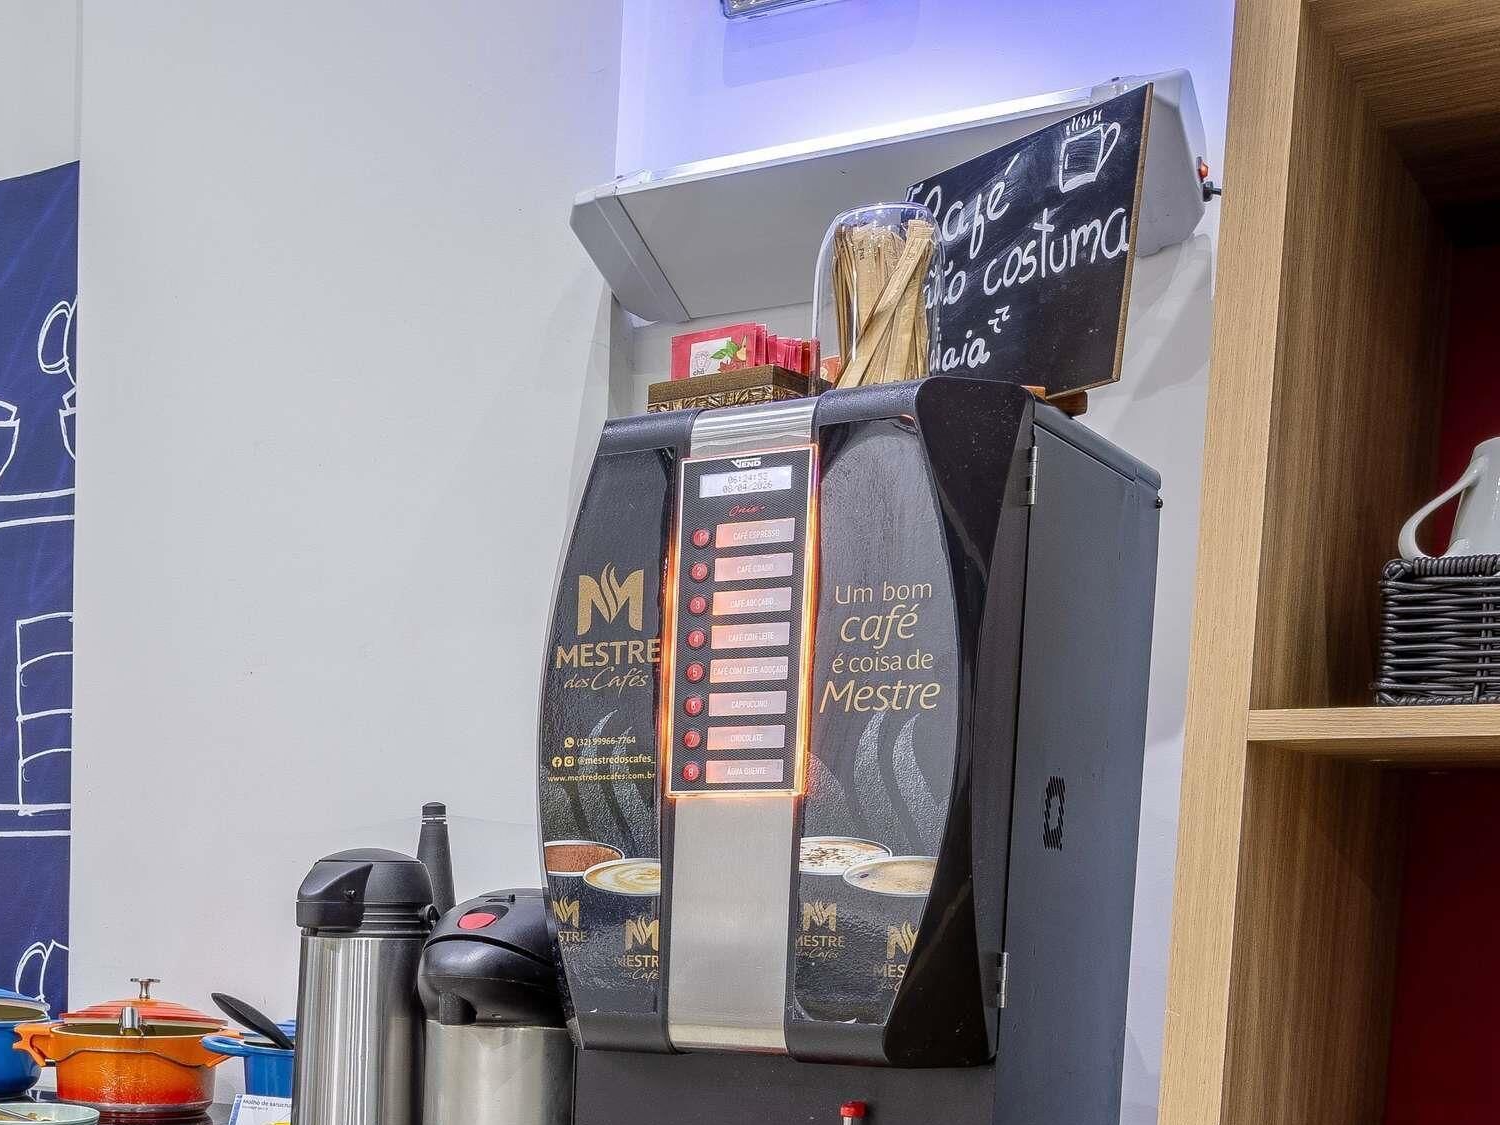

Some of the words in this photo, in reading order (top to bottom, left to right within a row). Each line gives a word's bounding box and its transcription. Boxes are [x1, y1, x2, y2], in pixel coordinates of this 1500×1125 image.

[983, 207, 1130, 297] costuma
[749, 528, 780, 539] ESPRESSO
[834, 584, 873, 605] Um
[882, 580, 933, 601] bom
[840, 603, 920, 650] café
[556, 637, 661, 669] MESTRE
[832, 652, 845, 674] é
[849, 651, 902, 673] coisa
[906, 648, 934, 670] de
[590, 665, 649, 698] Cafés
[744, 665, 759, 675] LEITE
[819, 679, 941, 713] Mestre
[730, 732, 764, 743] CHOCOLATE
[743, 766, 767, 776] QUENTE
